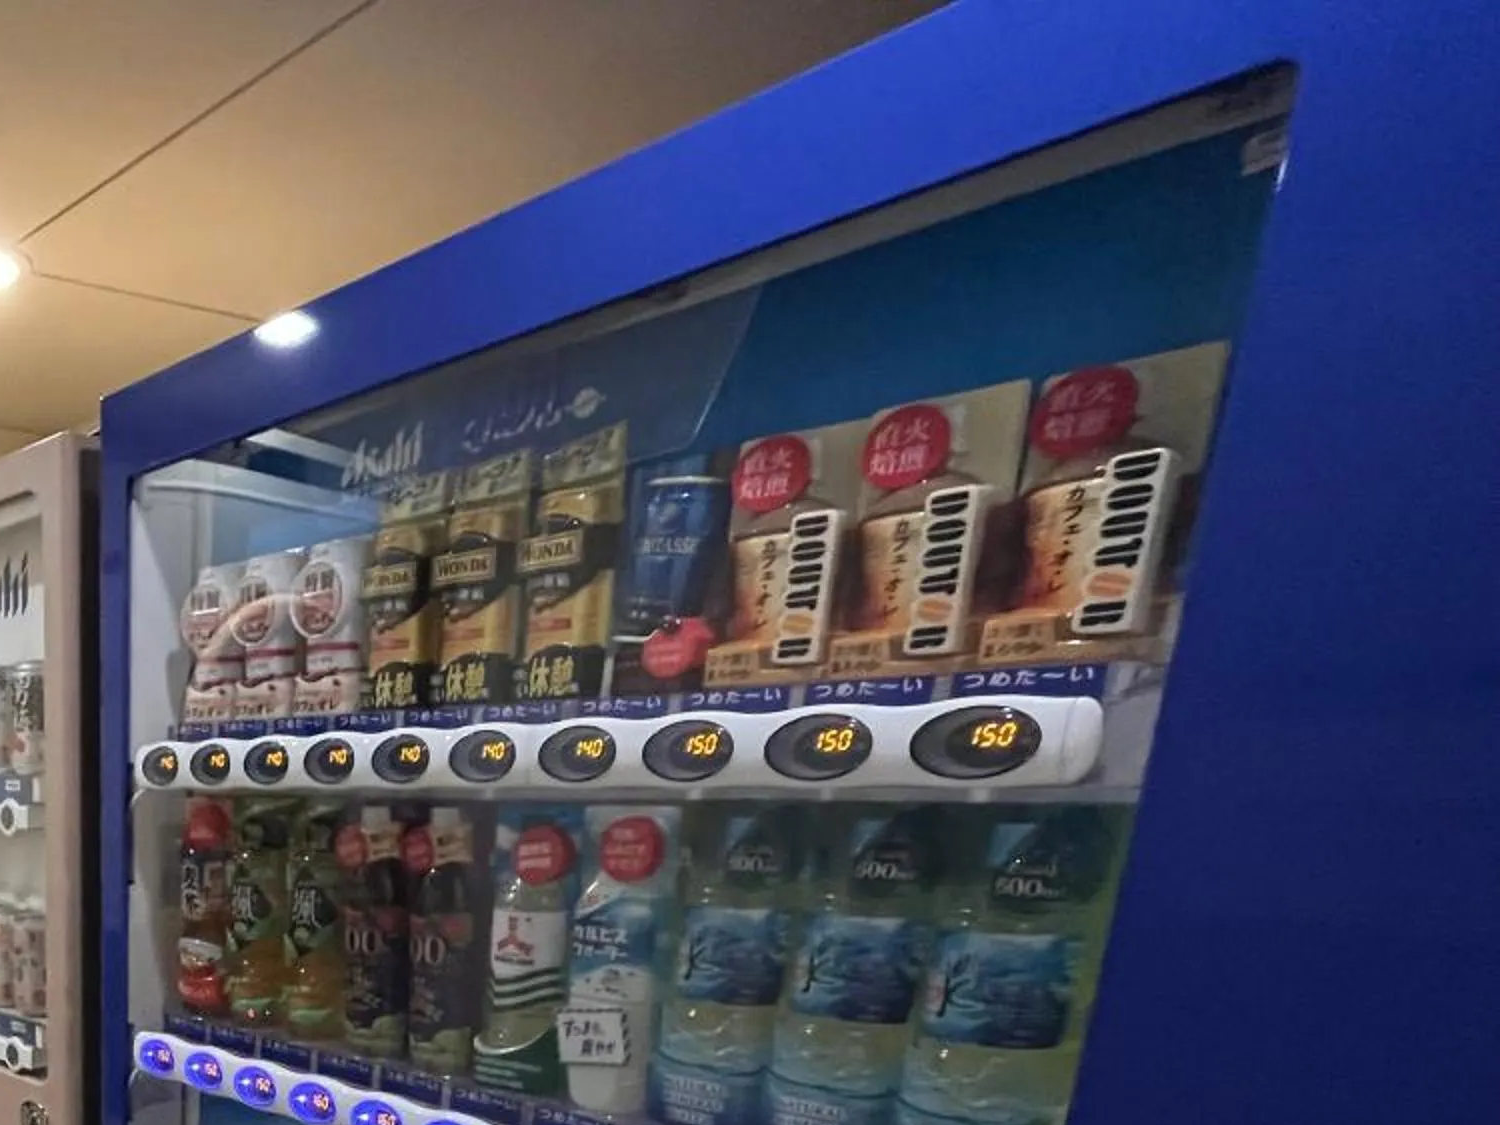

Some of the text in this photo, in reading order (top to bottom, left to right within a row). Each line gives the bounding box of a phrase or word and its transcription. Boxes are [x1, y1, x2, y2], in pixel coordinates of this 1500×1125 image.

[341, 420, 424, 489] Asahi
[686, 733, 719, 755] 150
[816, 728, 854, 752] 150
[970, 721, 1018, 747] 150
[481, 742, 505, 760] 140
[576, 738, 604, 757] 140
